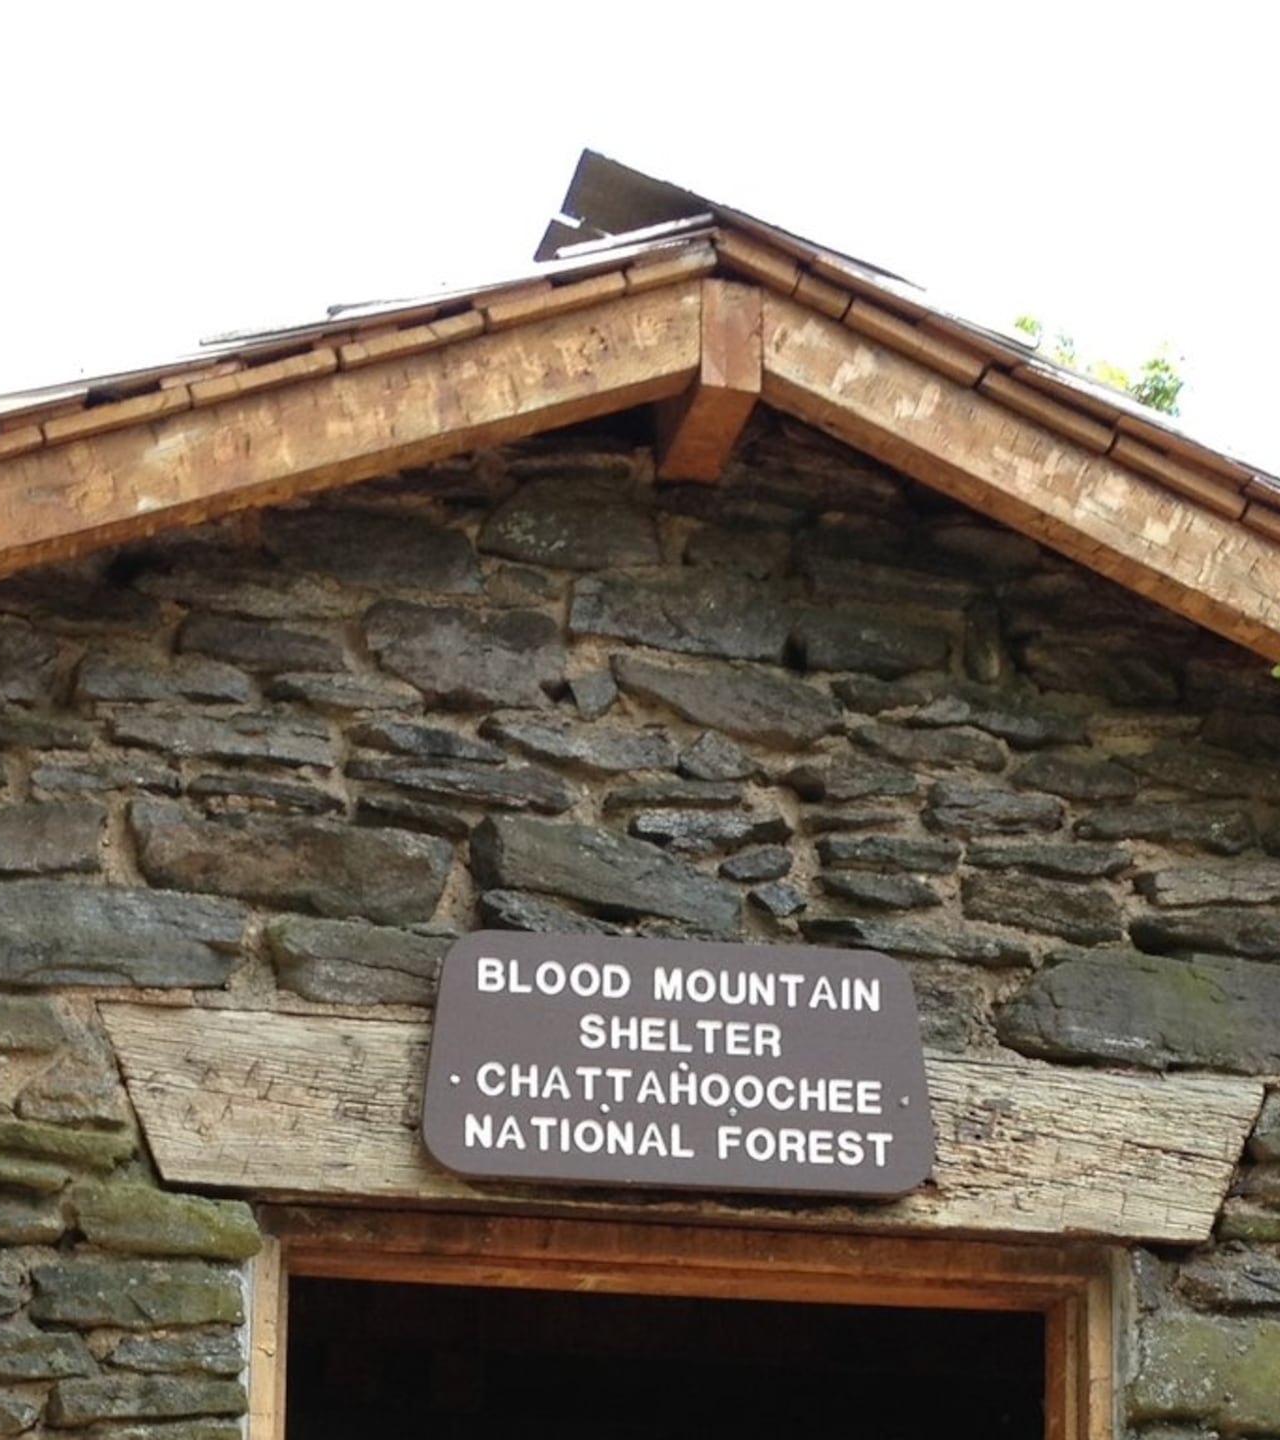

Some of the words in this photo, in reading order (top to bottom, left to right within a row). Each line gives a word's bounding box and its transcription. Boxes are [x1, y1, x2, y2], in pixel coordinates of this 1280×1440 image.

[477, 957, 631, 999] BLOOD
[654, 966, 880, 1012] MOUNTAIN
[579, 1013, 782, 1058] SHELTER
[476, 1061, 882, 1115] CHATTAHOOCHEE
[464, 1113, 695, 1158] NATIONAL
[717, 1125, 894, 1167] FOREST
